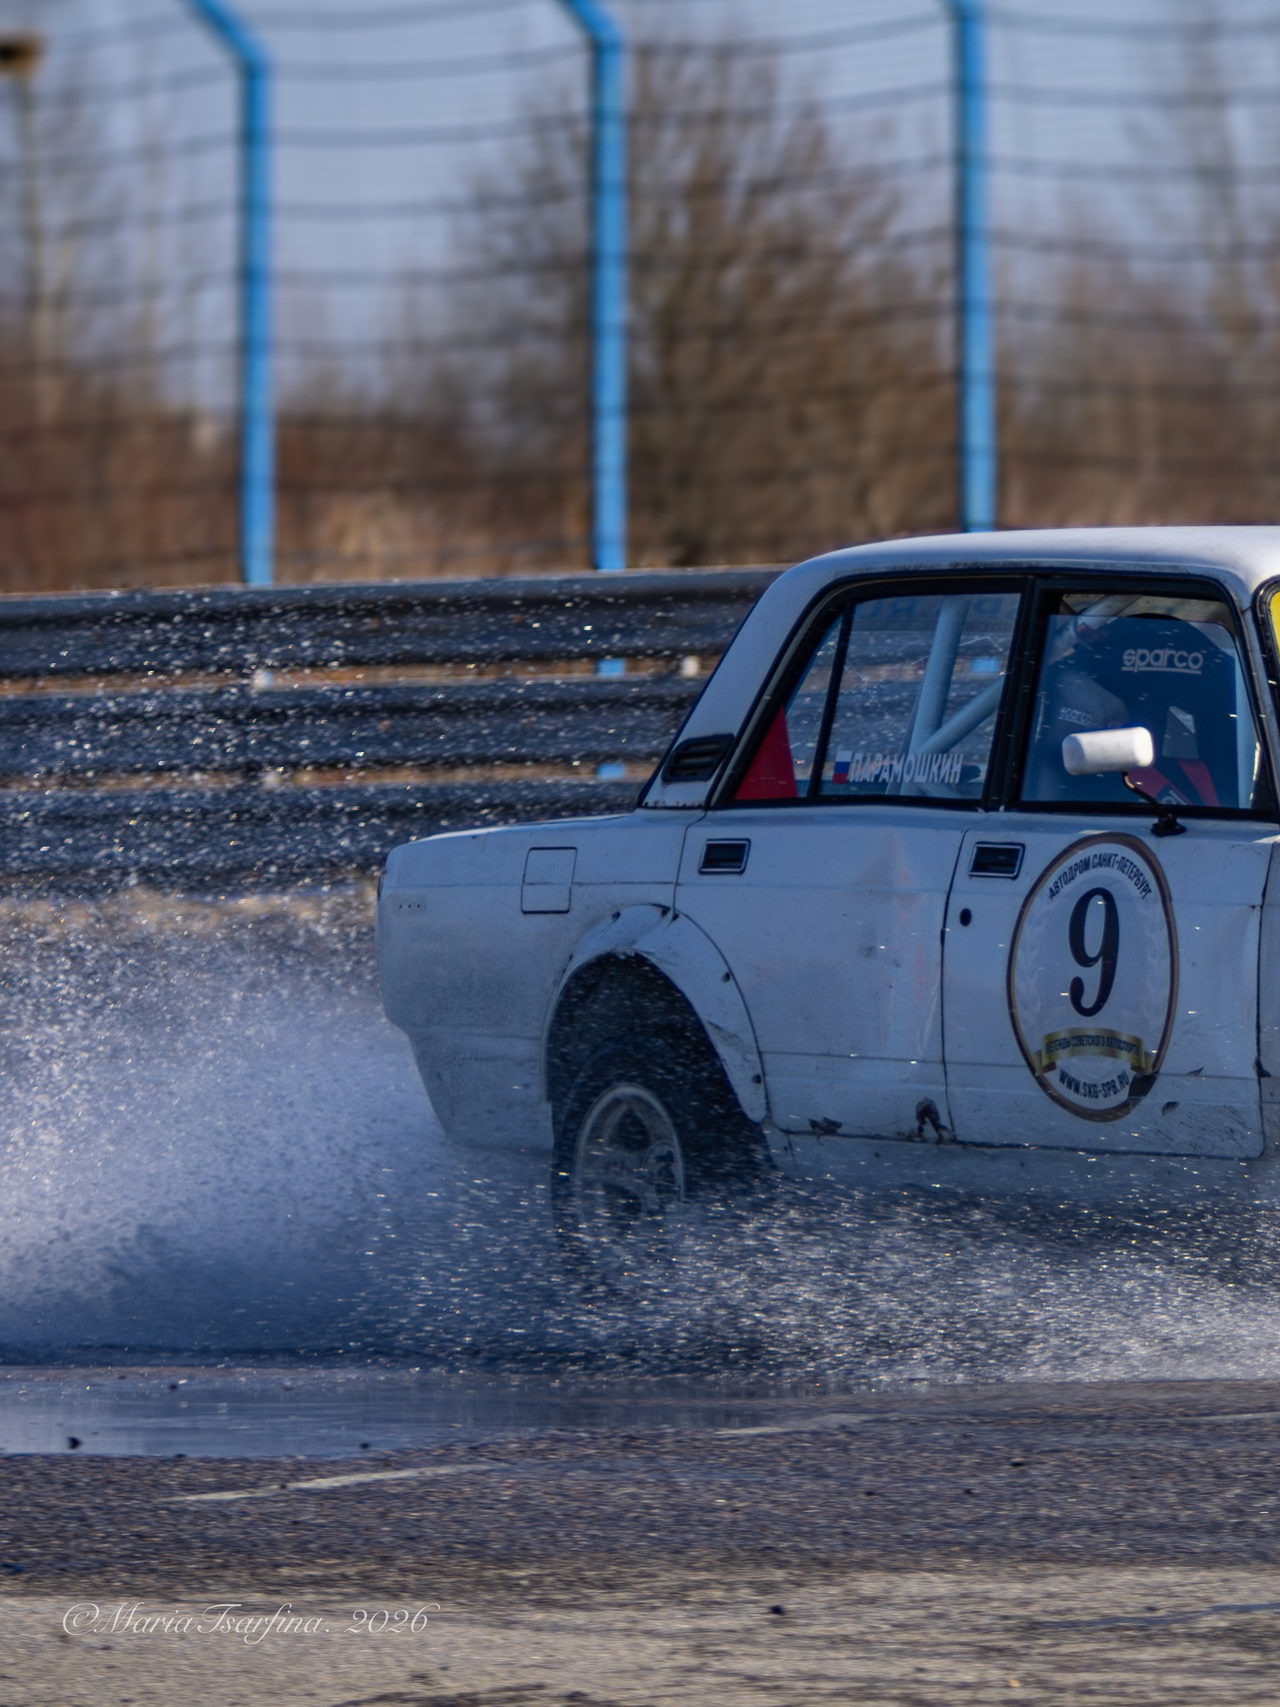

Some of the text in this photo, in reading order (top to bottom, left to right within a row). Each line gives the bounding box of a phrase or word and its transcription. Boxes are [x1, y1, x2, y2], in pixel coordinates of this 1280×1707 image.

[1121, 647, 1204, 674] sparco
[849, 752, 964, 783] ПАРАМОШКИН
[1048, 852, 1153, 900] АВТОДРОМ САНКТ-ПЕТЕРБУРГ
[1068, 886, 1120, 1018] 9
[1059, 1067, 1130, 1099] WWW.SKG-SPB.RU
